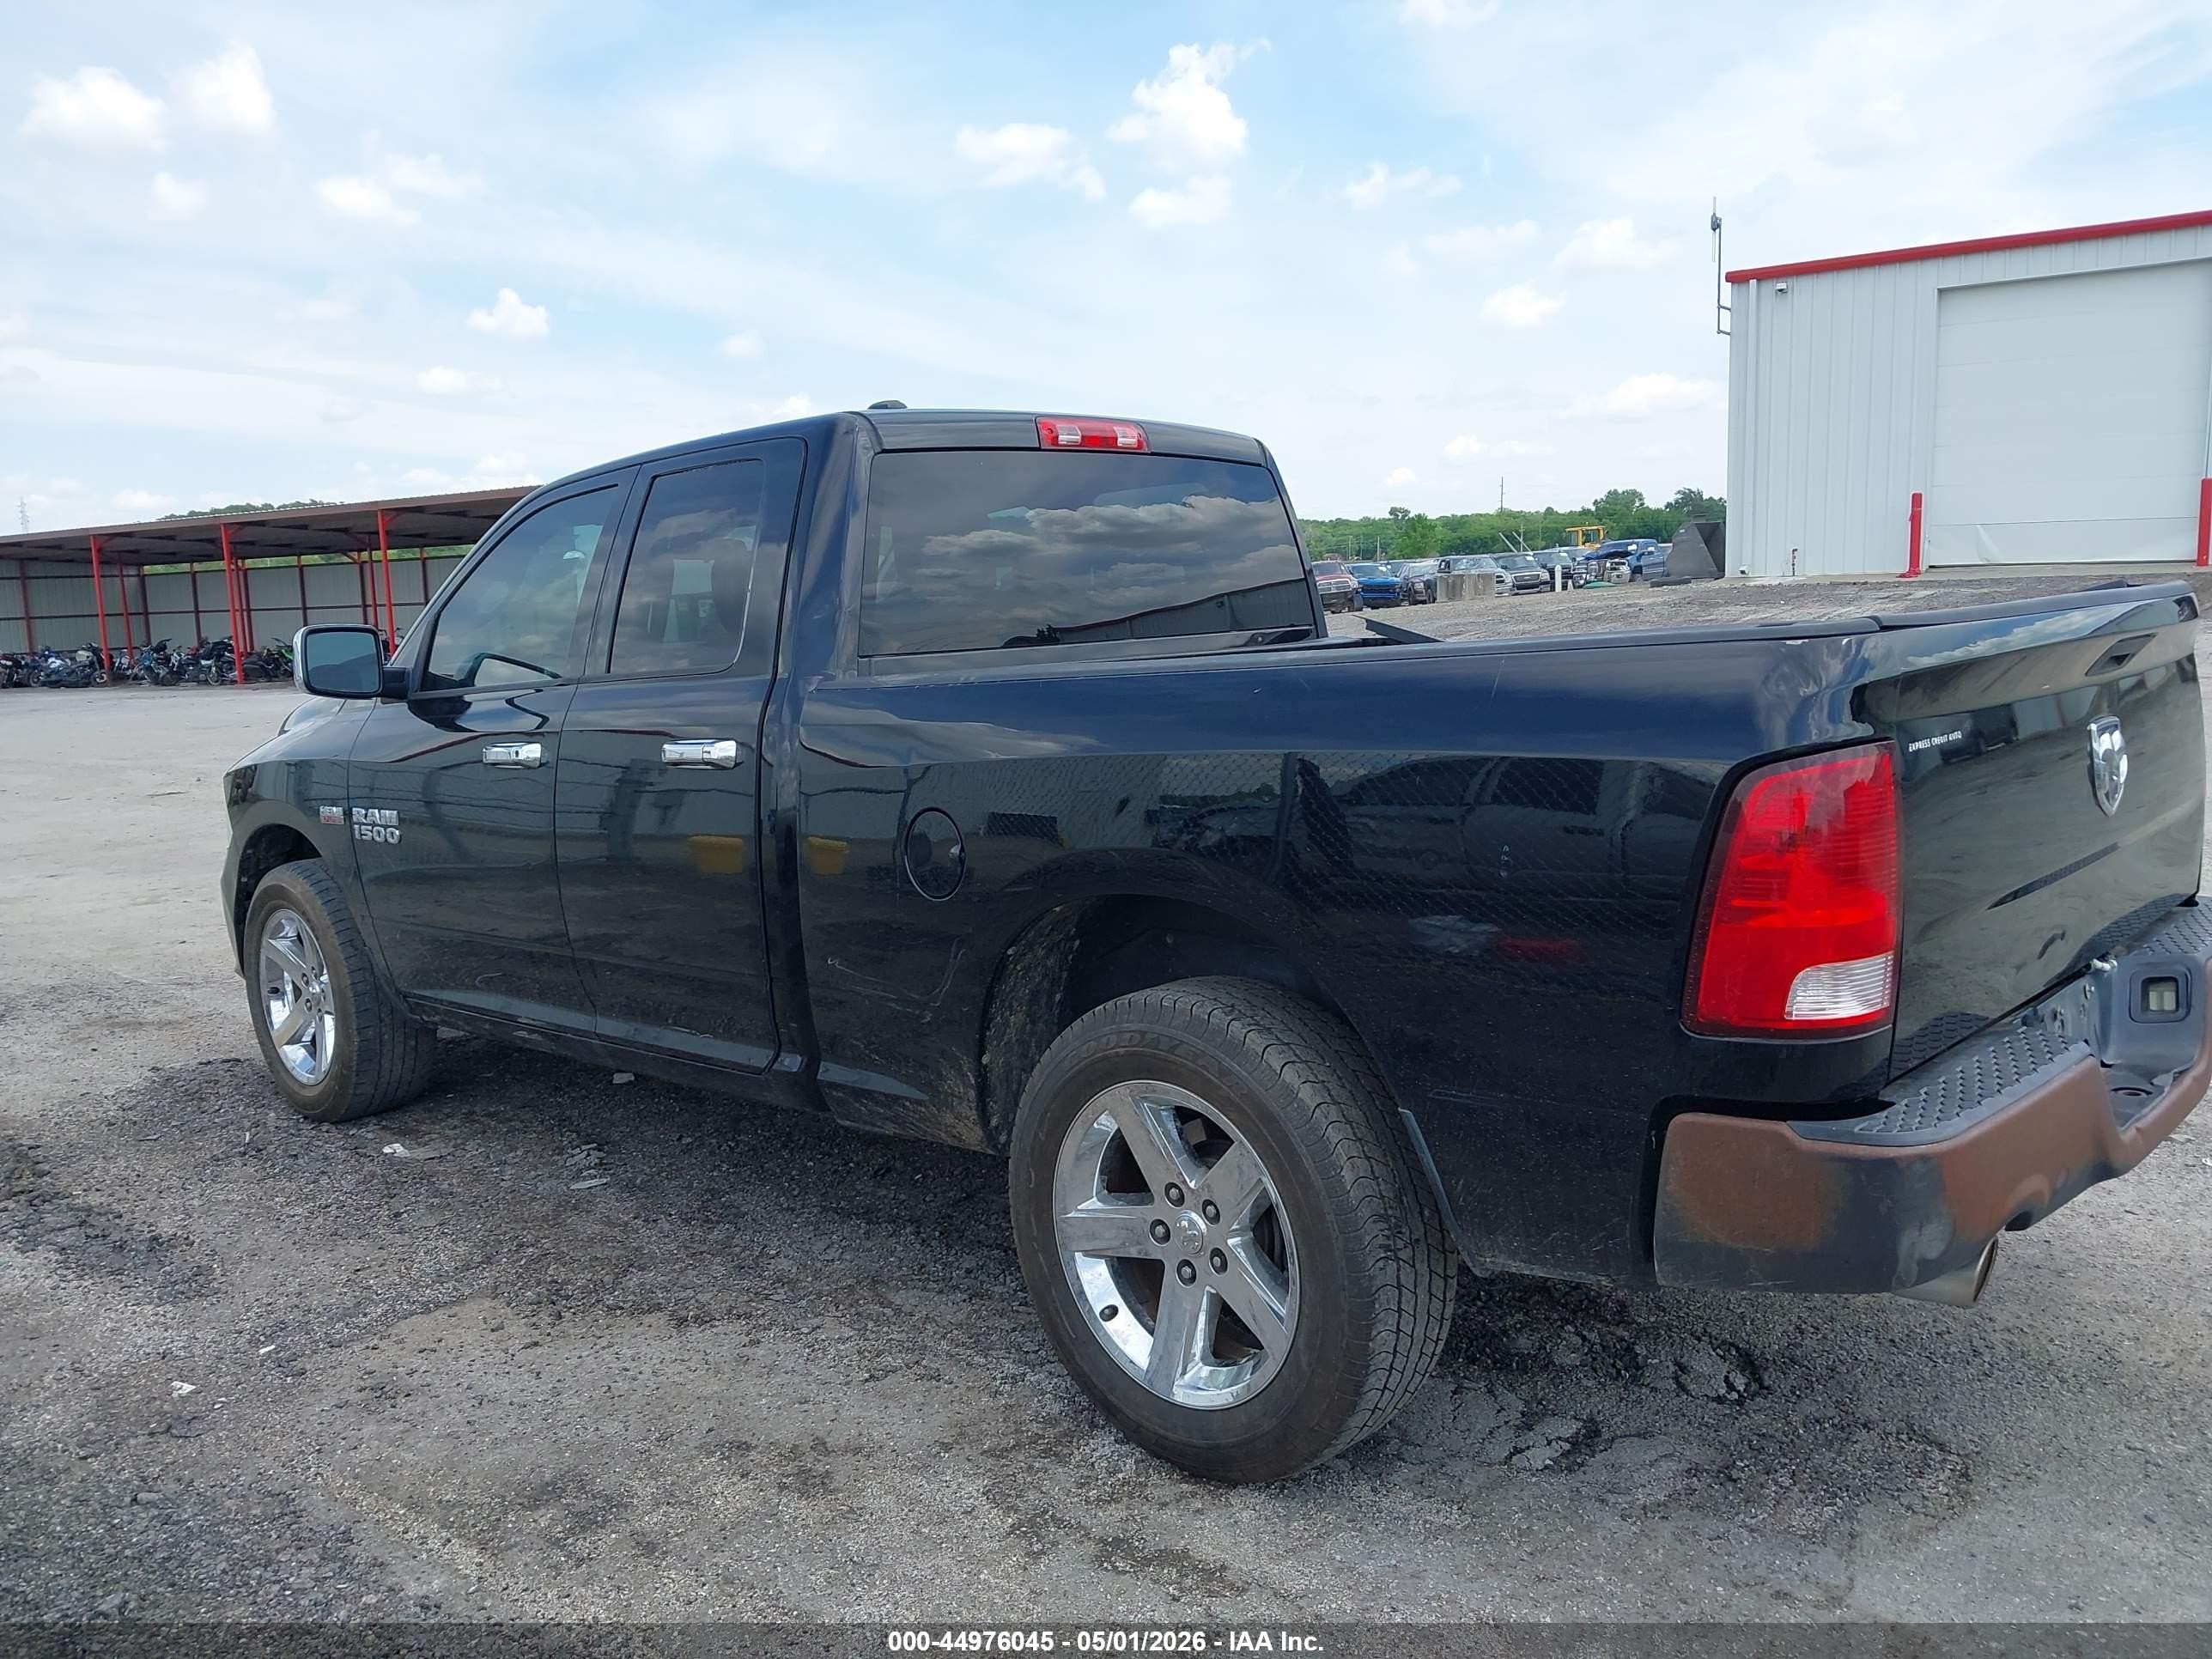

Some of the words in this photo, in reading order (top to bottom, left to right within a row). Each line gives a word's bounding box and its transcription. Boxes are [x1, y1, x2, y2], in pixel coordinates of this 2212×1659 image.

[1909, 738, 1930, 752] EXPRESS
[1931, 734, 1948, 745] CREDIT
[1949, 731, 1962, 740] AUTO
[352, 807, 398, 825] RAM
[354, 824, 400, 844] 1500
